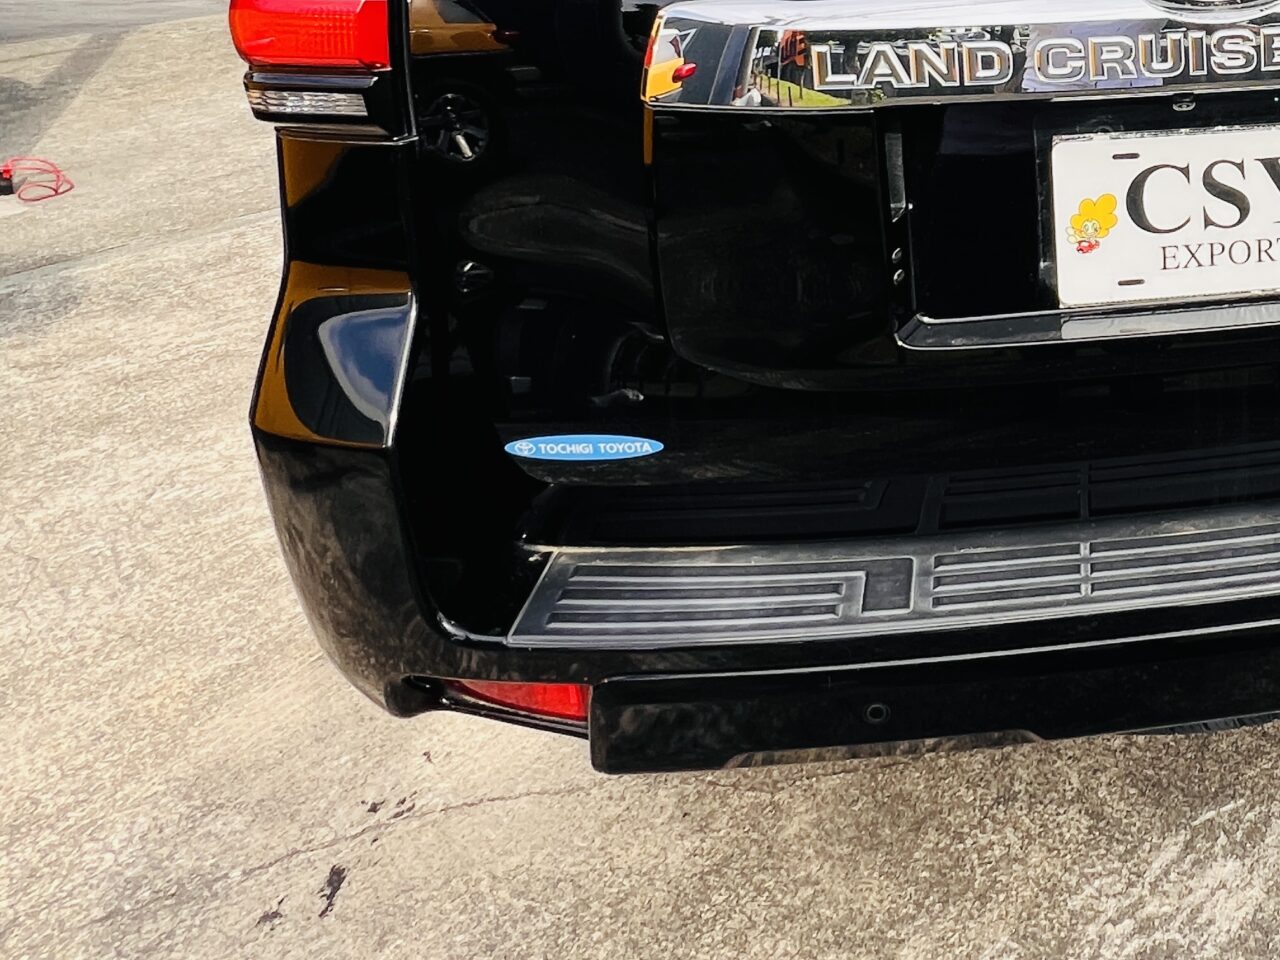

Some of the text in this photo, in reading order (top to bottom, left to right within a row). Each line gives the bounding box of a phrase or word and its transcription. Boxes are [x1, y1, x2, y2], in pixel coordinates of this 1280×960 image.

[810, 40, 1013, 90] LAND
[538, 442, 652, 454] TOCHIGI TOYOTA
